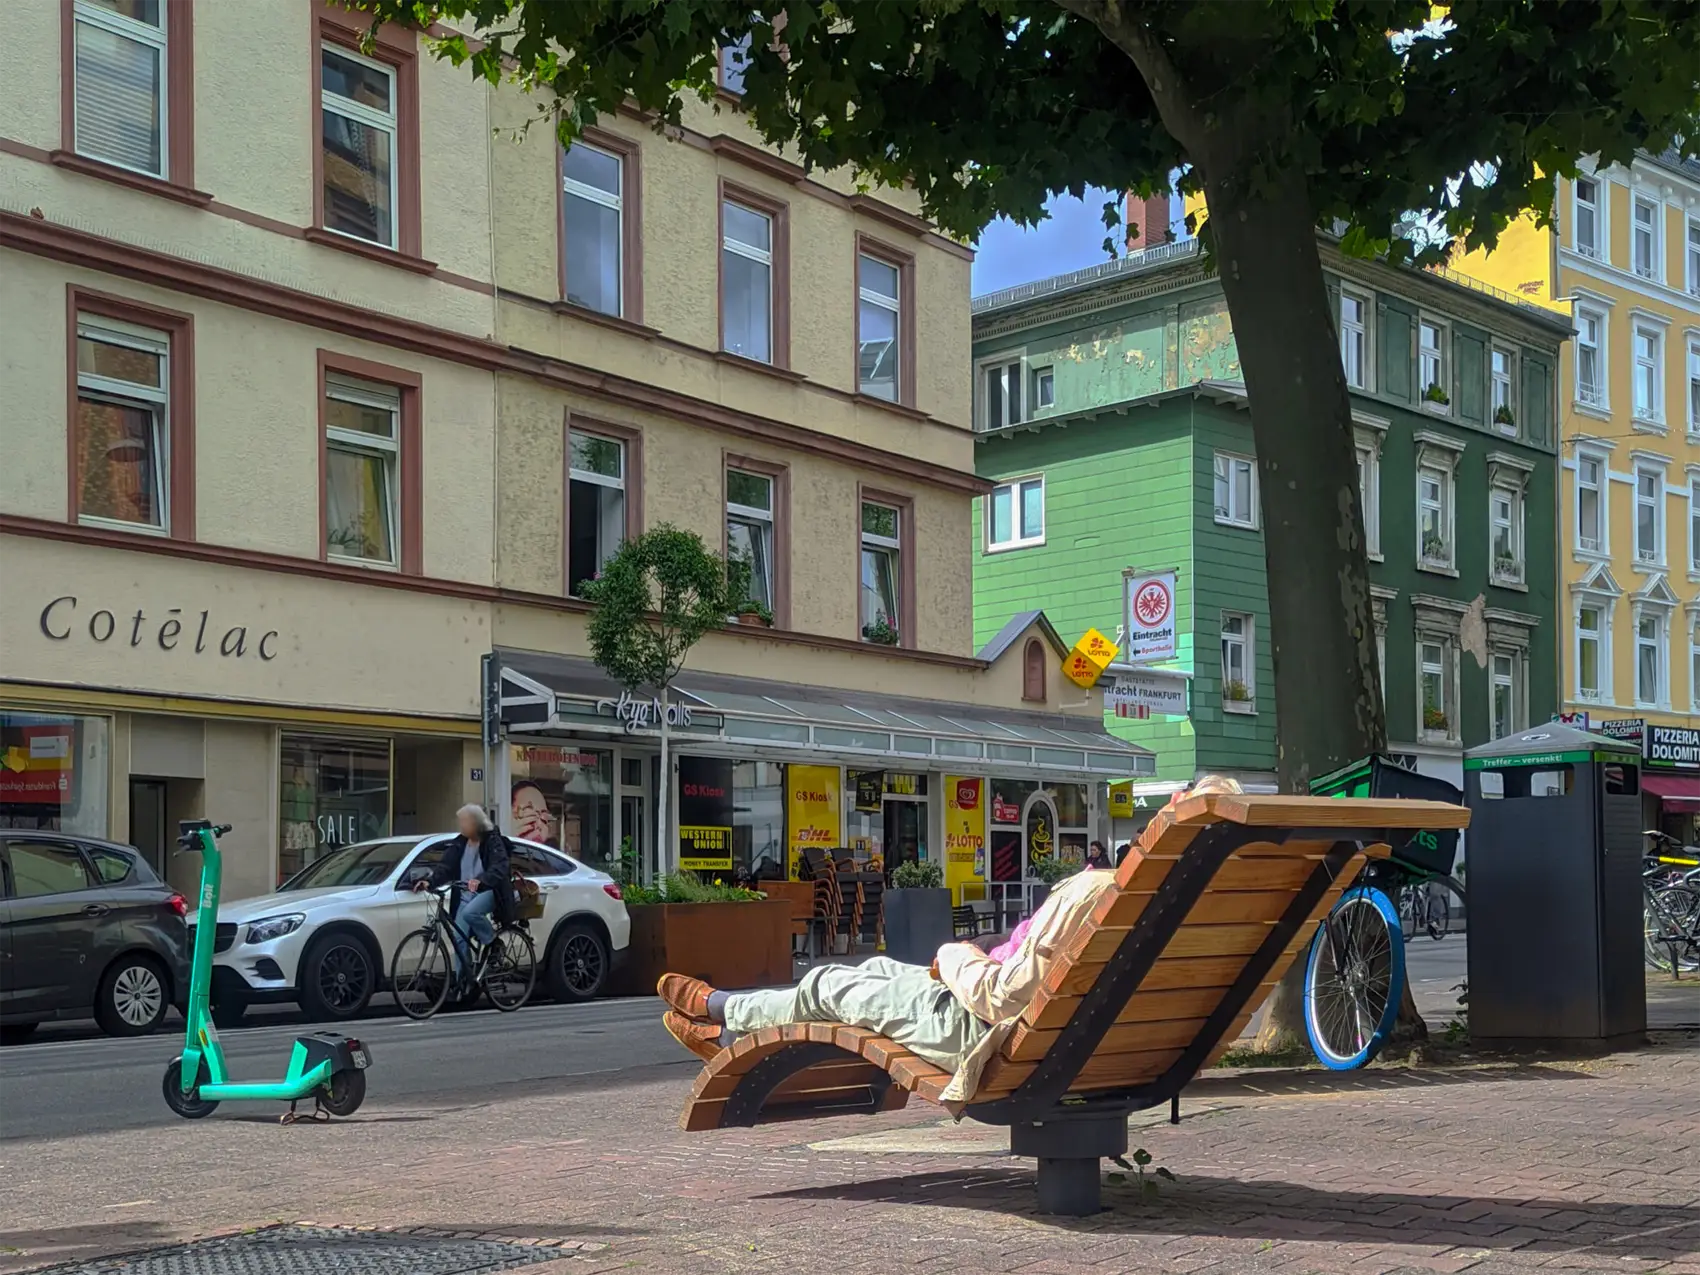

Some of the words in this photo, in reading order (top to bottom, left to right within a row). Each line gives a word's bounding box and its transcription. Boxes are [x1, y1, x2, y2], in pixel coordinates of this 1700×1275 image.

[1133, 628, 1172, 640] Eintracht
[1088, 649, 1111, 657] LOTTO
[1139, 688, 1182, 701] FRANKFURT
[1604, 719, 1642, 728] PIZZERIA
[1654, 727, 1700, 745] PIZZERIA
[1483, 758, 1512, 767] Treffer
[1522, 754, 1562, 764] versenkt!
[684, 784, 698, 796] GS
[698, 785, 725, 798] Kiosk
[796, 790, 808, 802] GS
[809, 791, 833, 802] Kiosk
[317, 814, 356, 845] SALE
[680, 829, 723, 840] WESTERN
[693, 839, 723, 850] UNION
[957, 834, 983, 848] LOTTO
